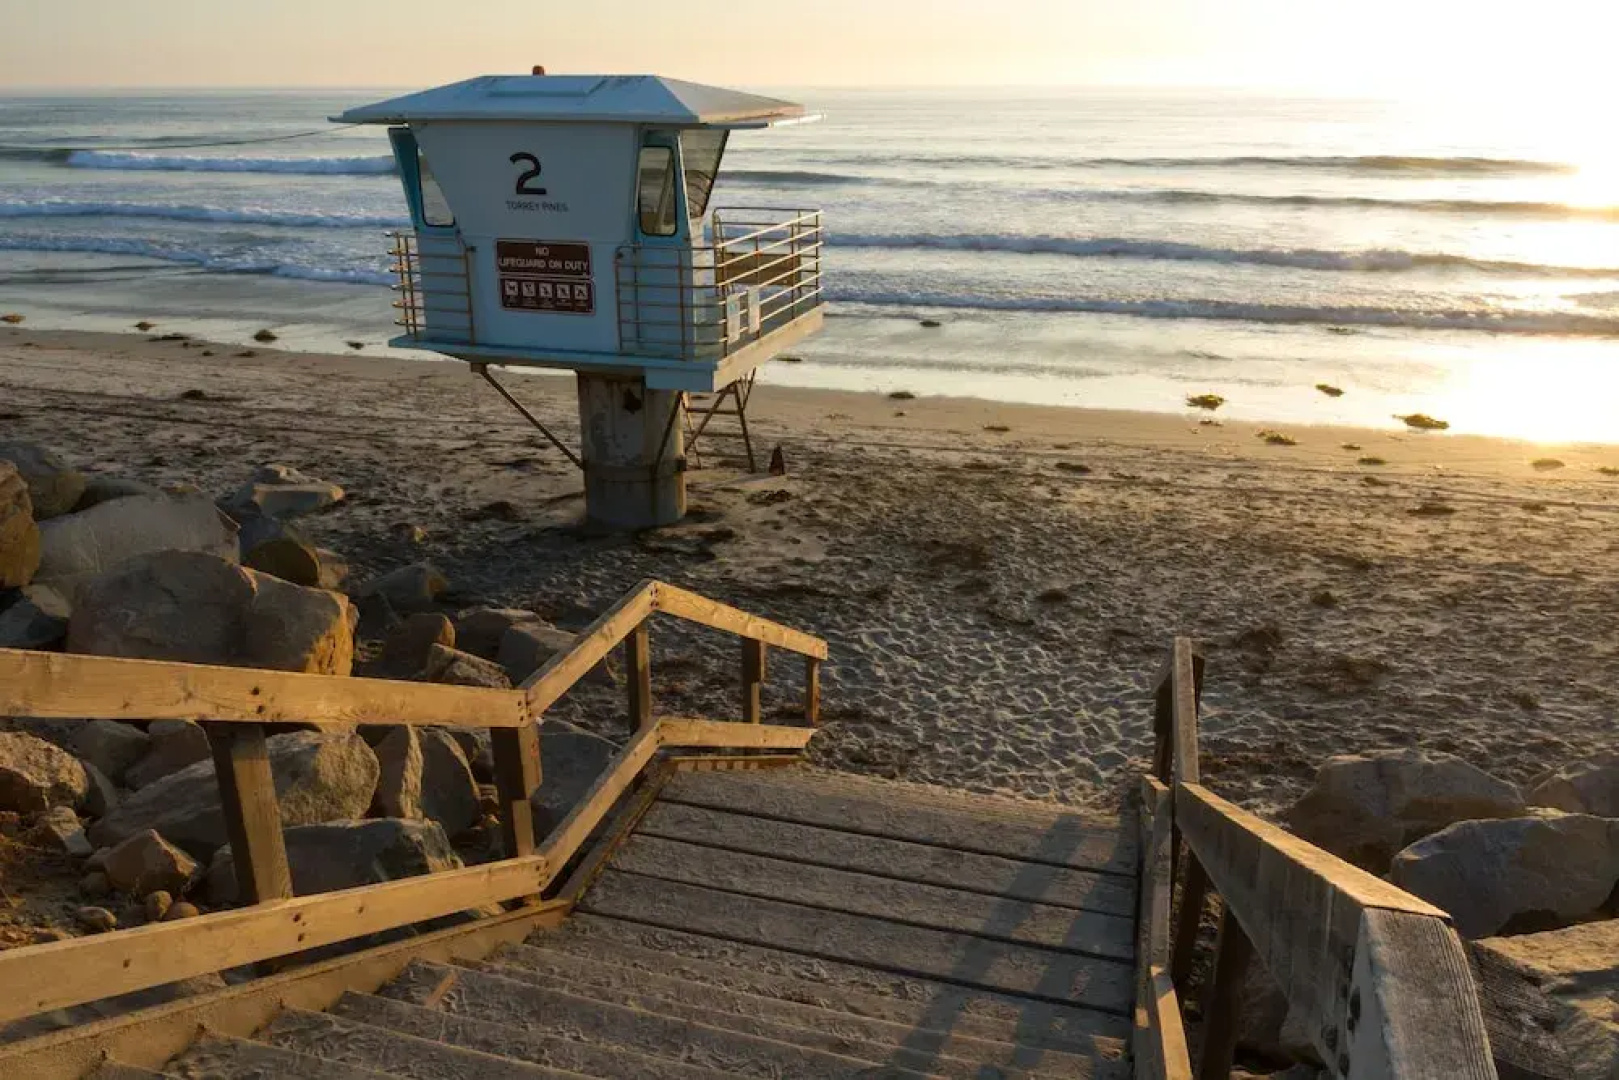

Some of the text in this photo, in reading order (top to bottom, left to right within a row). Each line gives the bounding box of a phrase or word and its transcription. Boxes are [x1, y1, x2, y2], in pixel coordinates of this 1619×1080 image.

[509, 152, 547, 194] 2
[505, 200, 569, 212] TORREY PINES
[535, 247, 549, 256] NO
[499, 257, 588, 270] LIFEGUARD ON DUTY
